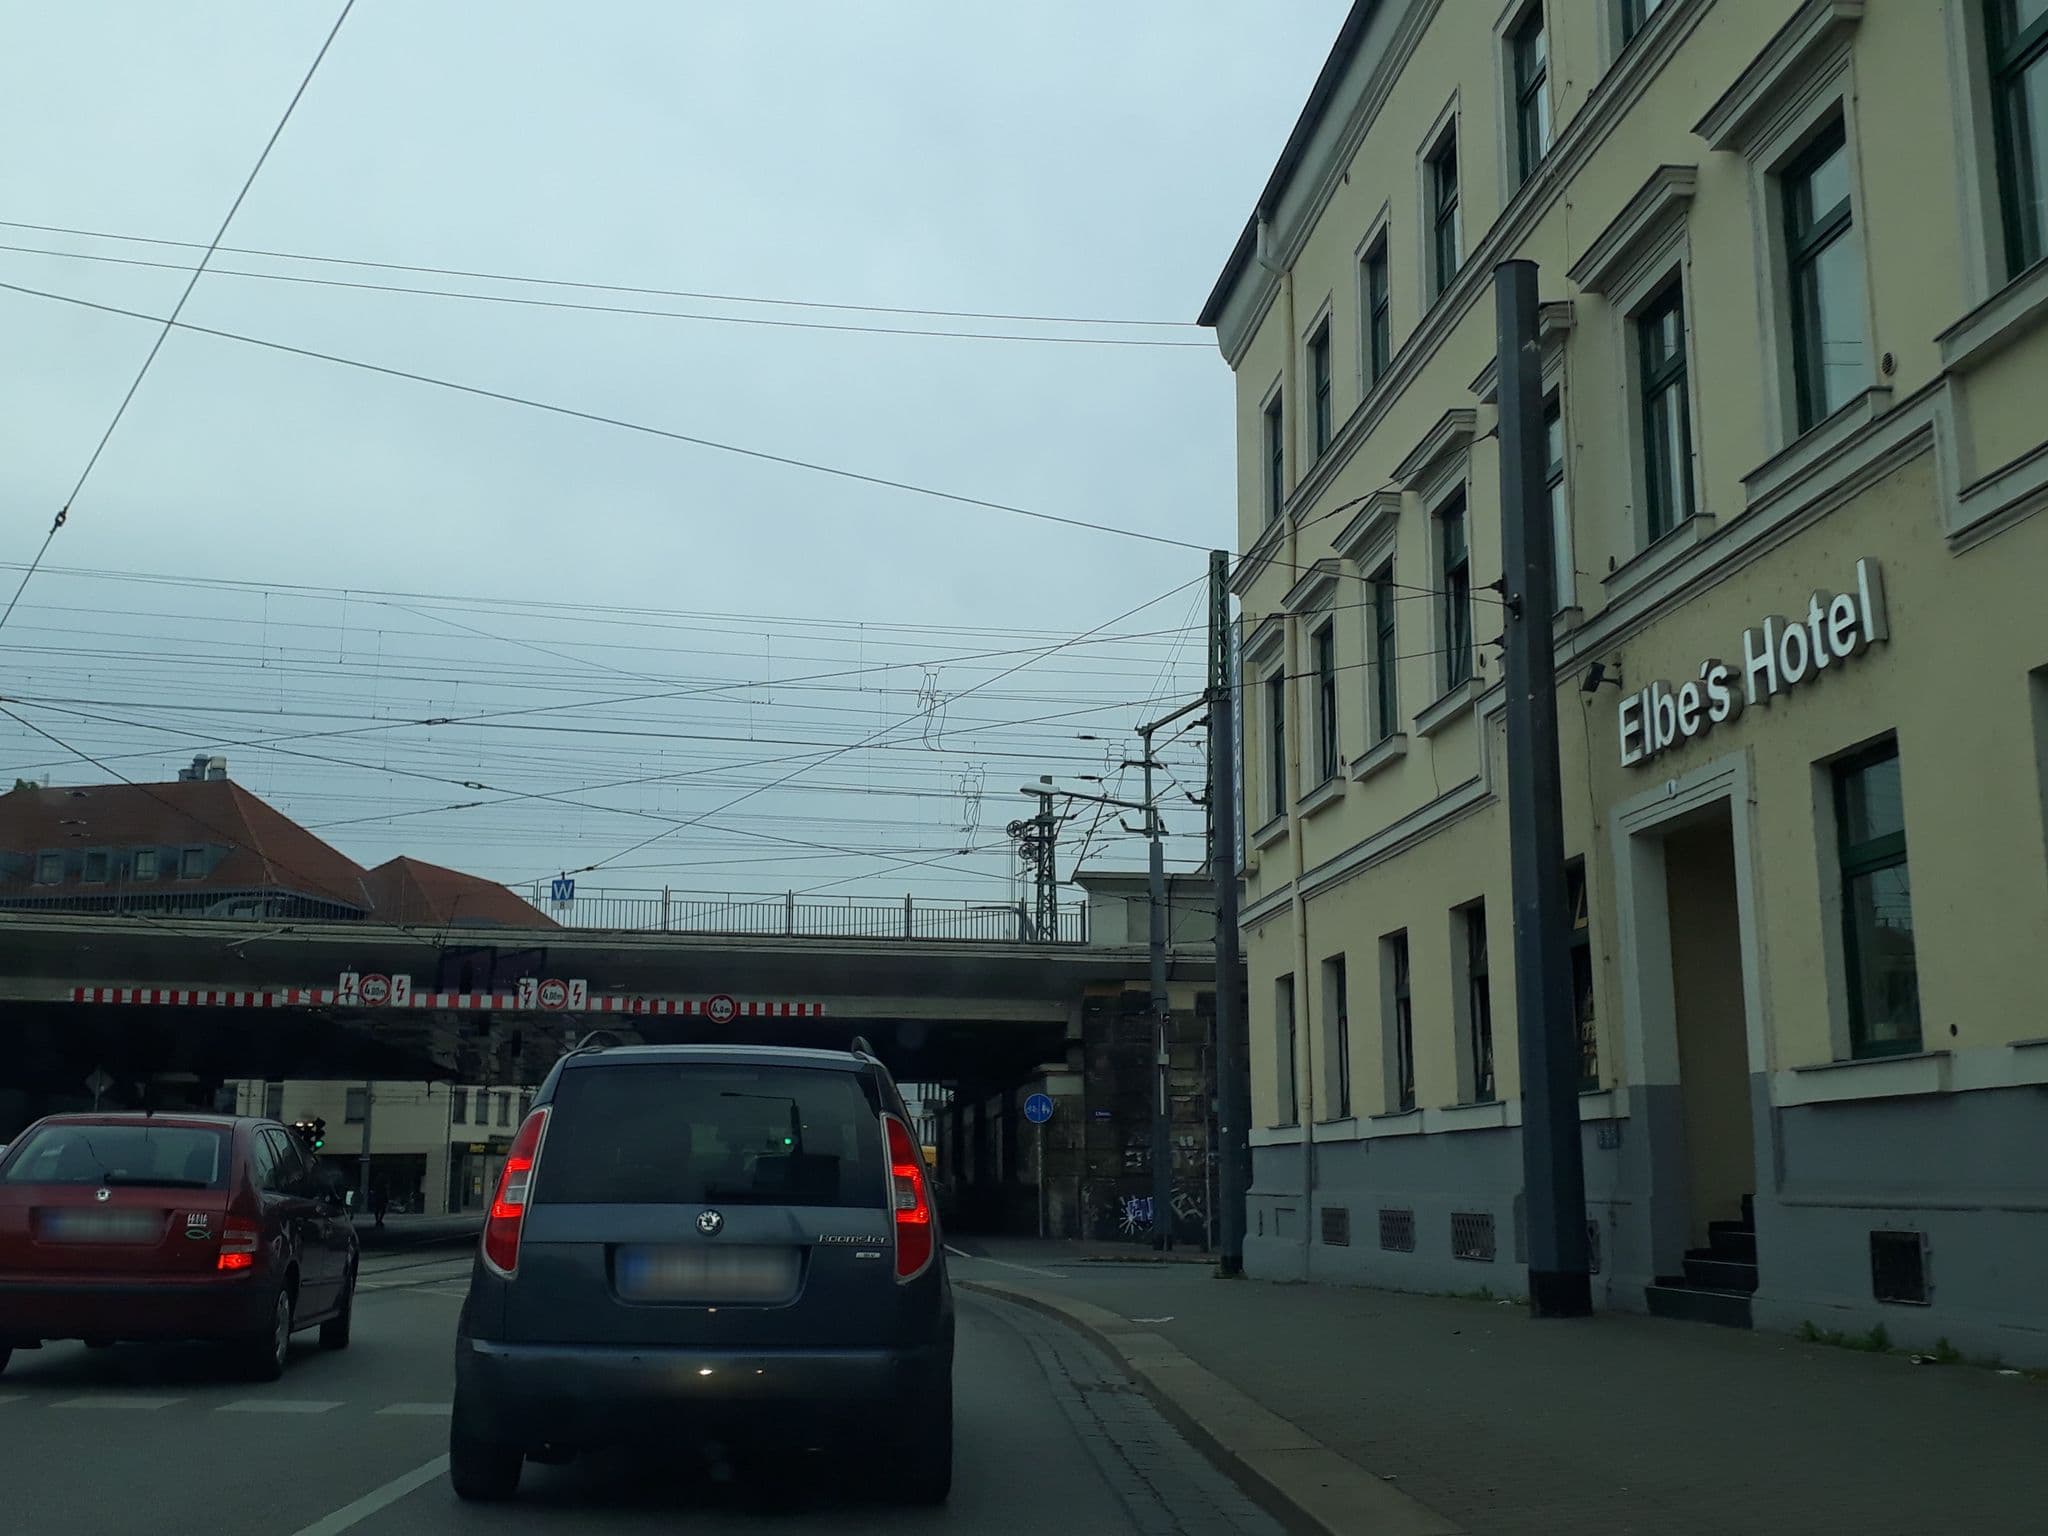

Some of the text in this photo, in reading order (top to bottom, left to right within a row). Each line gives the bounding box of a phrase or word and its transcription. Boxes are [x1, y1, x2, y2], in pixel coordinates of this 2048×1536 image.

[1743, 557, 1881, 705] Hotel
[1232, 626, 1243, 865] SPIELHALLE
[553, 882, 573, 899] W
